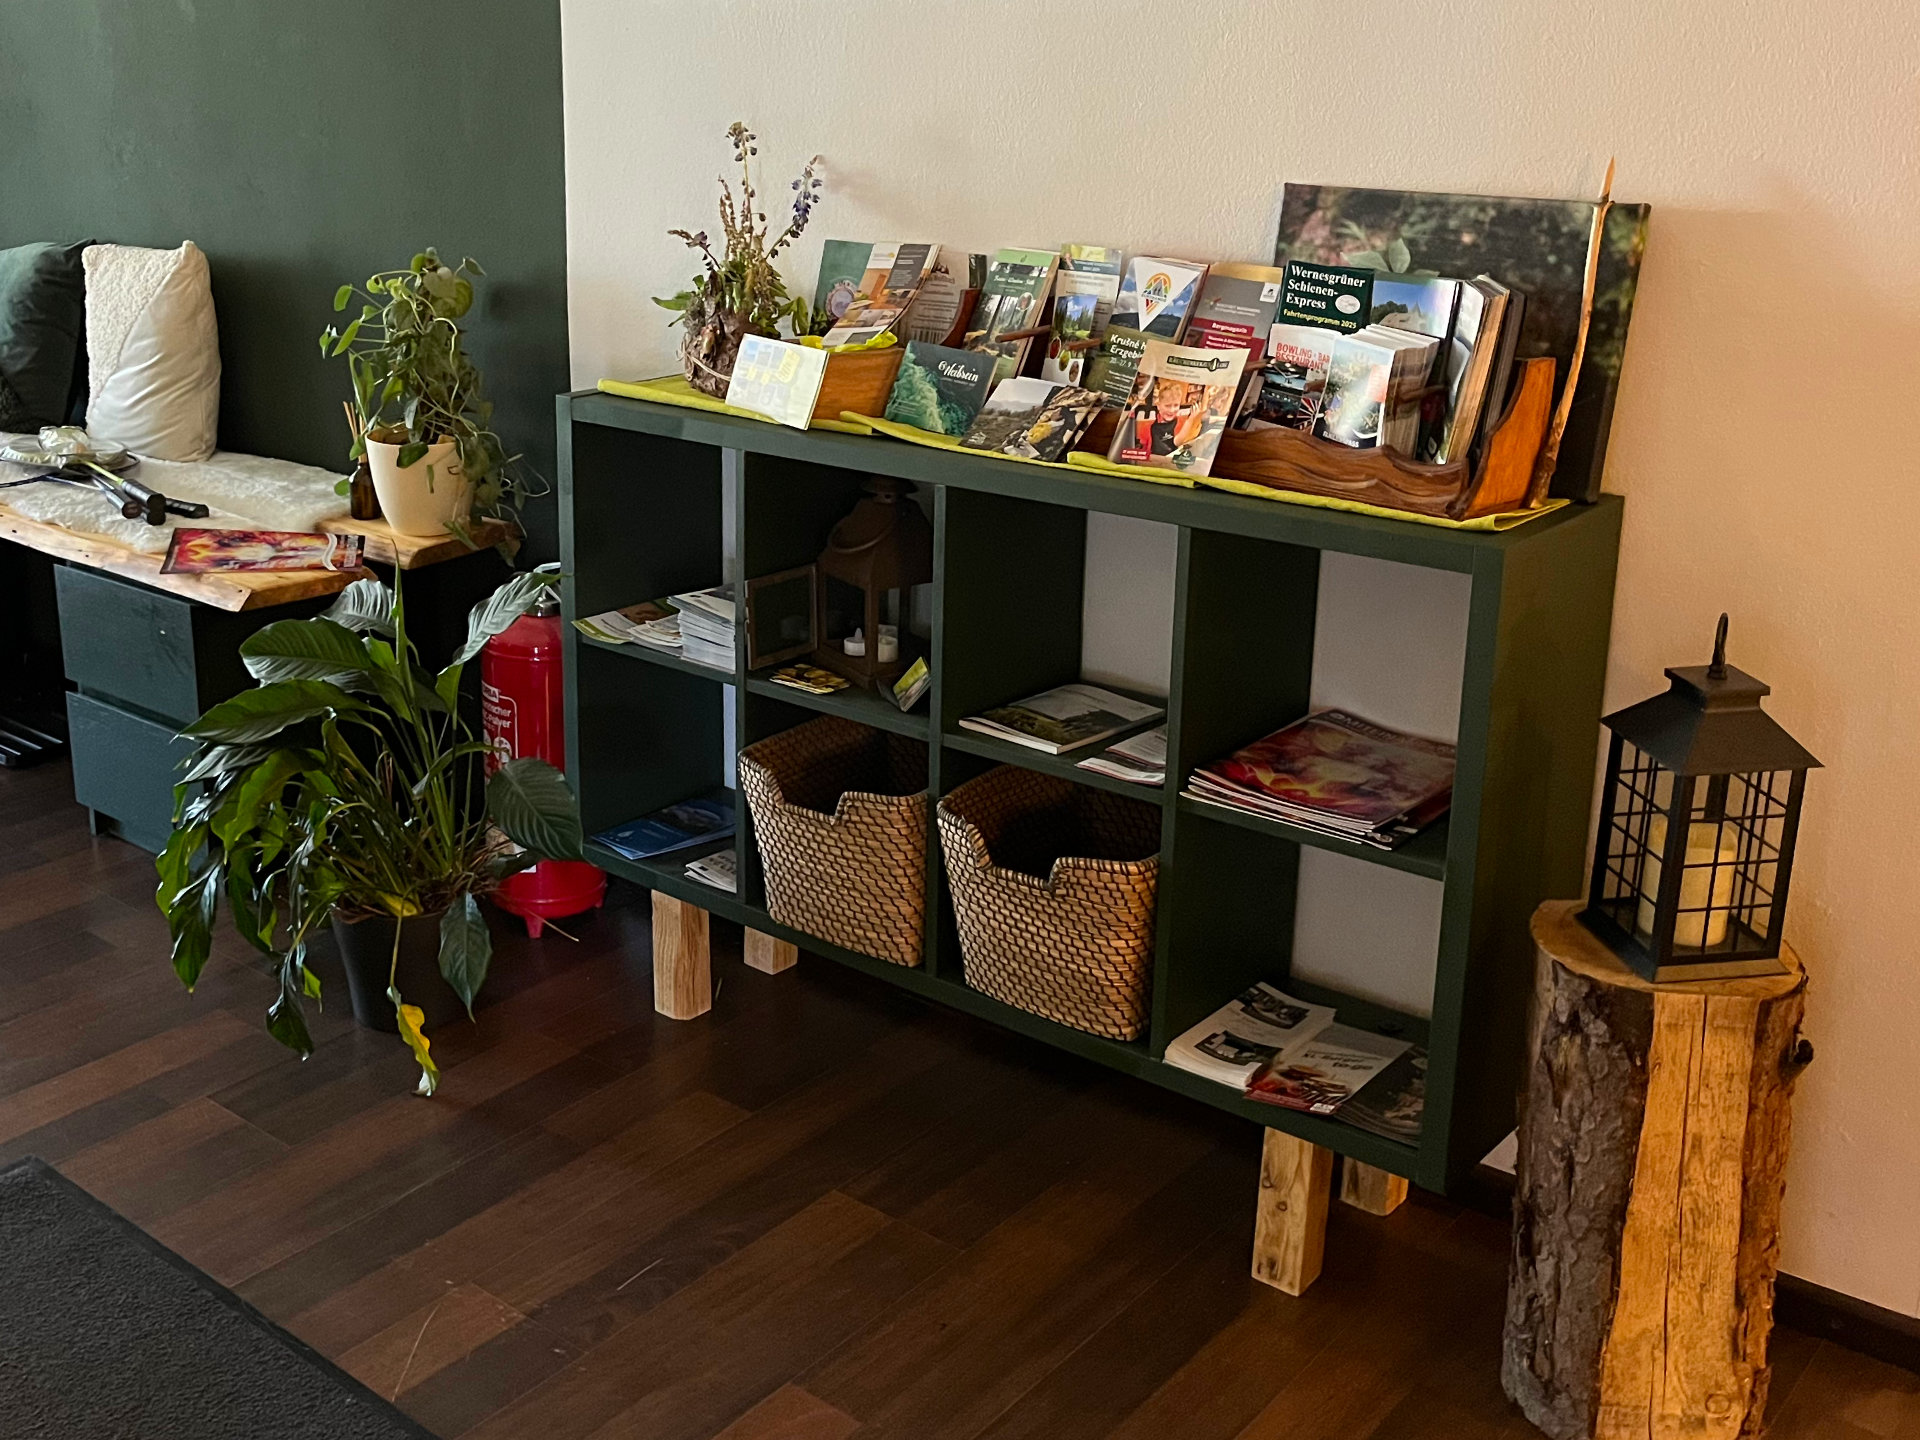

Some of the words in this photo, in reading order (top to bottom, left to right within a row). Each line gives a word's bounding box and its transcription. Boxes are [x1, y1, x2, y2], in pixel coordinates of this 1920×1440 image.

[1291, 265, 1366, 288] Wernesgrüner
[1287, 279, 1339, 297] Schienen-
[1286, 292, 1327, 310] Express
[1283, 308, 1340, 326] Fahrtenprogramm
[1340, 319, 1357, 329] 2025
[1110, 334, 1140, 349] Krušné
[1276, 342, 1313, 359] BOWLING
[1275, 351, 1325, 371] RESTAURANT
